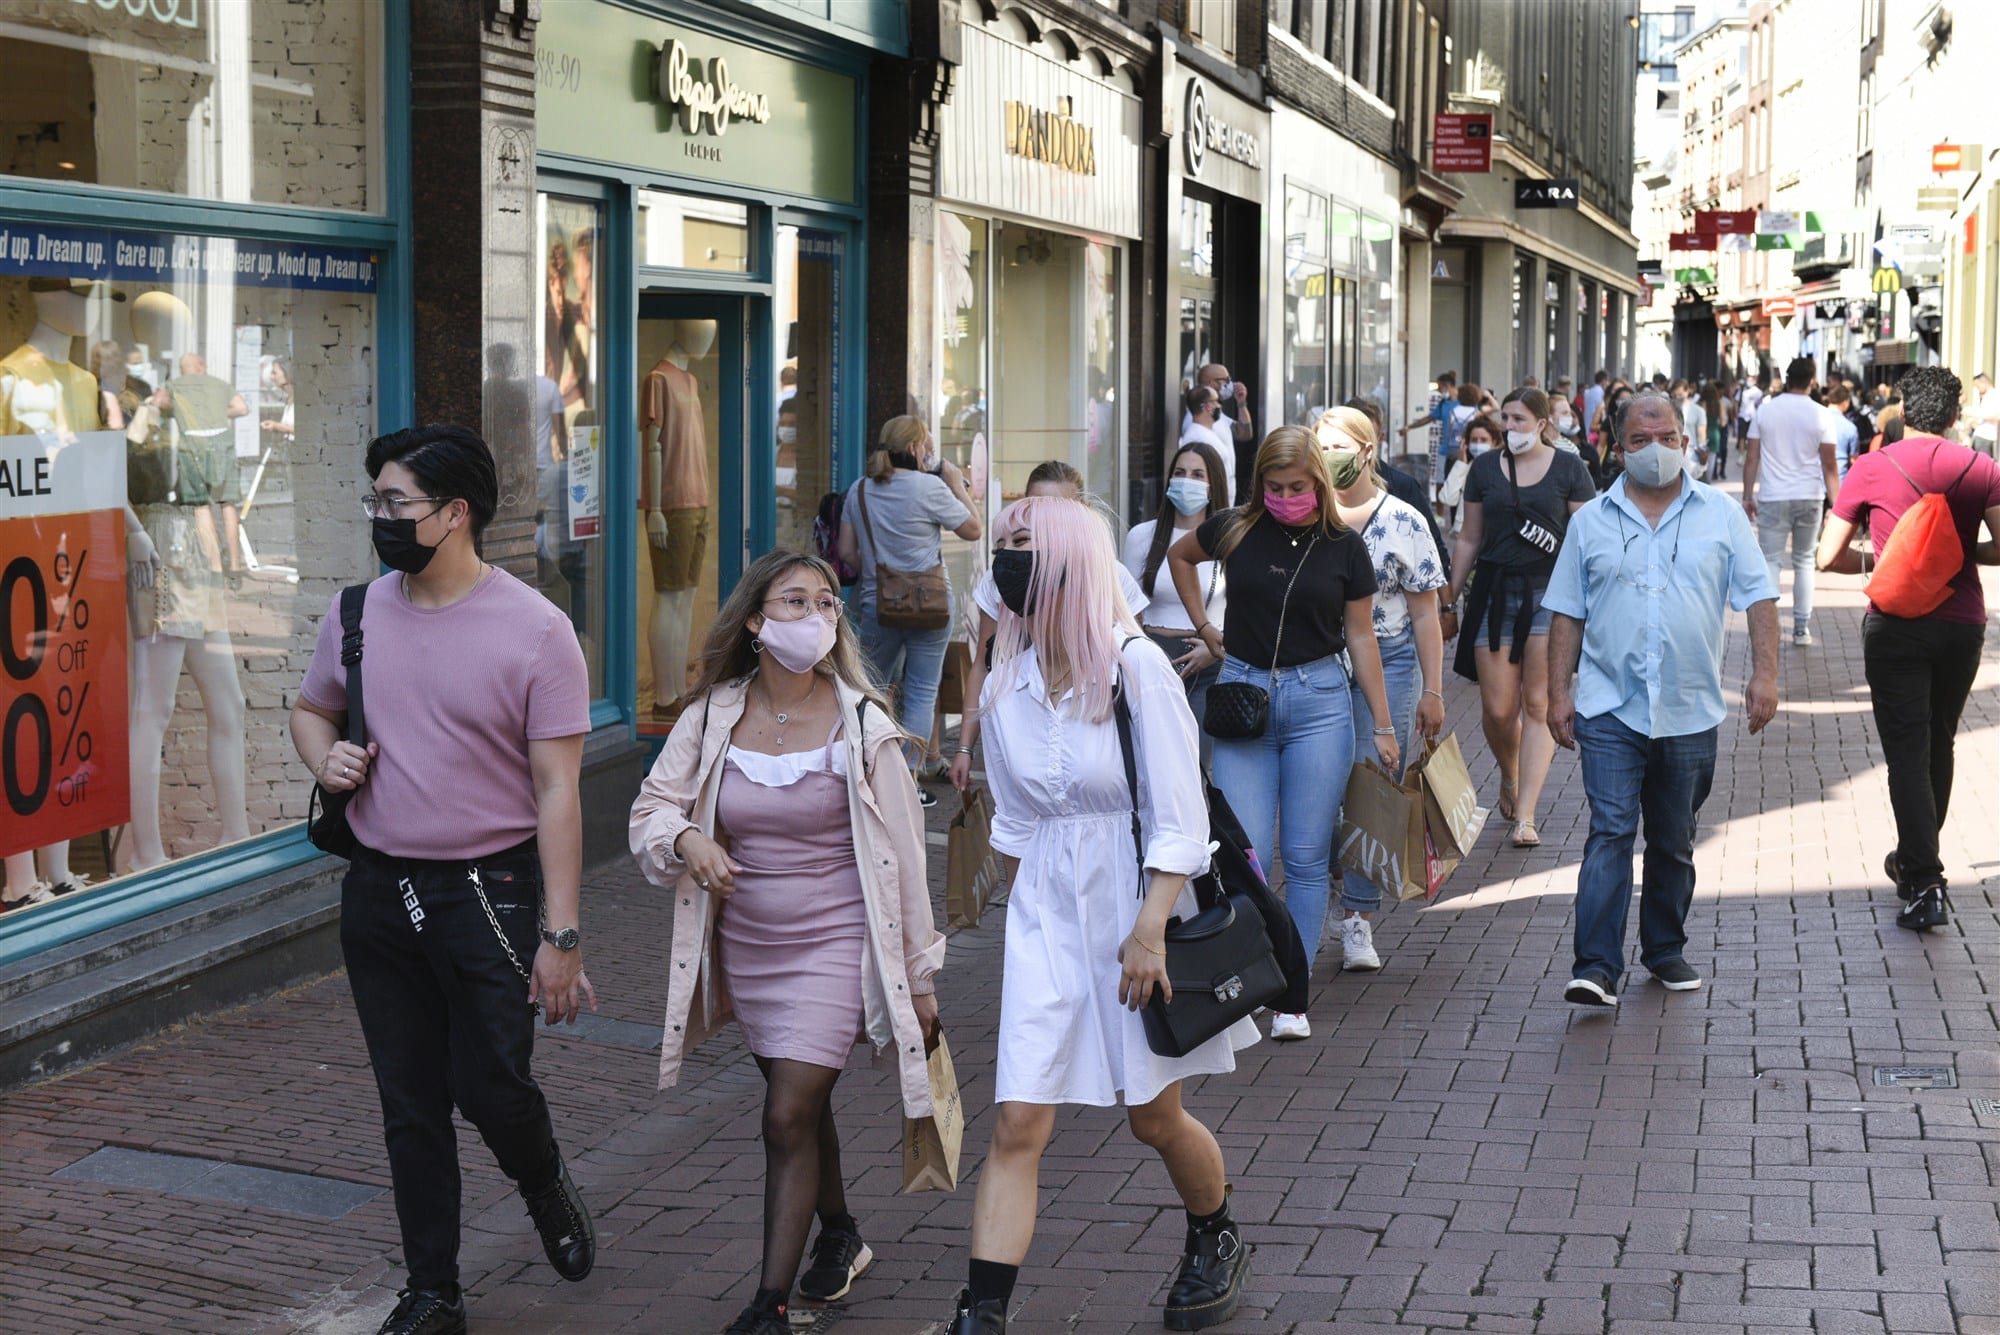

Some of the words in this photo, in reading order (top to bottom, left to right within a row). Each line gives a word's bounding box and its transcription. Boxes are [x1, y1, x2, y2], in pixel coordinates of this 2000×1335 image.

[663, 38, 714, 134] Pepe
[713, 57, 771, 136] Jeans
[1008, 100, 1096, 177] PANDORA
[11, 236, 34, 267] up.
[37, 233, 82, 263] Dream
[85, 241, 107, 270] up.
[116, 239, 146, 268] Care
[149, 246, 169, 274] up.
[258, 253, 276, 278] up.
[277, 251, 306, 276] Mood
[307, 257, 324, 283] up.
[325, 256, 357, 281] Dream
[358, 262, 375, 285] up.
[57, 640, 89, 672] Off
[58, 773, 90, 807] Off
